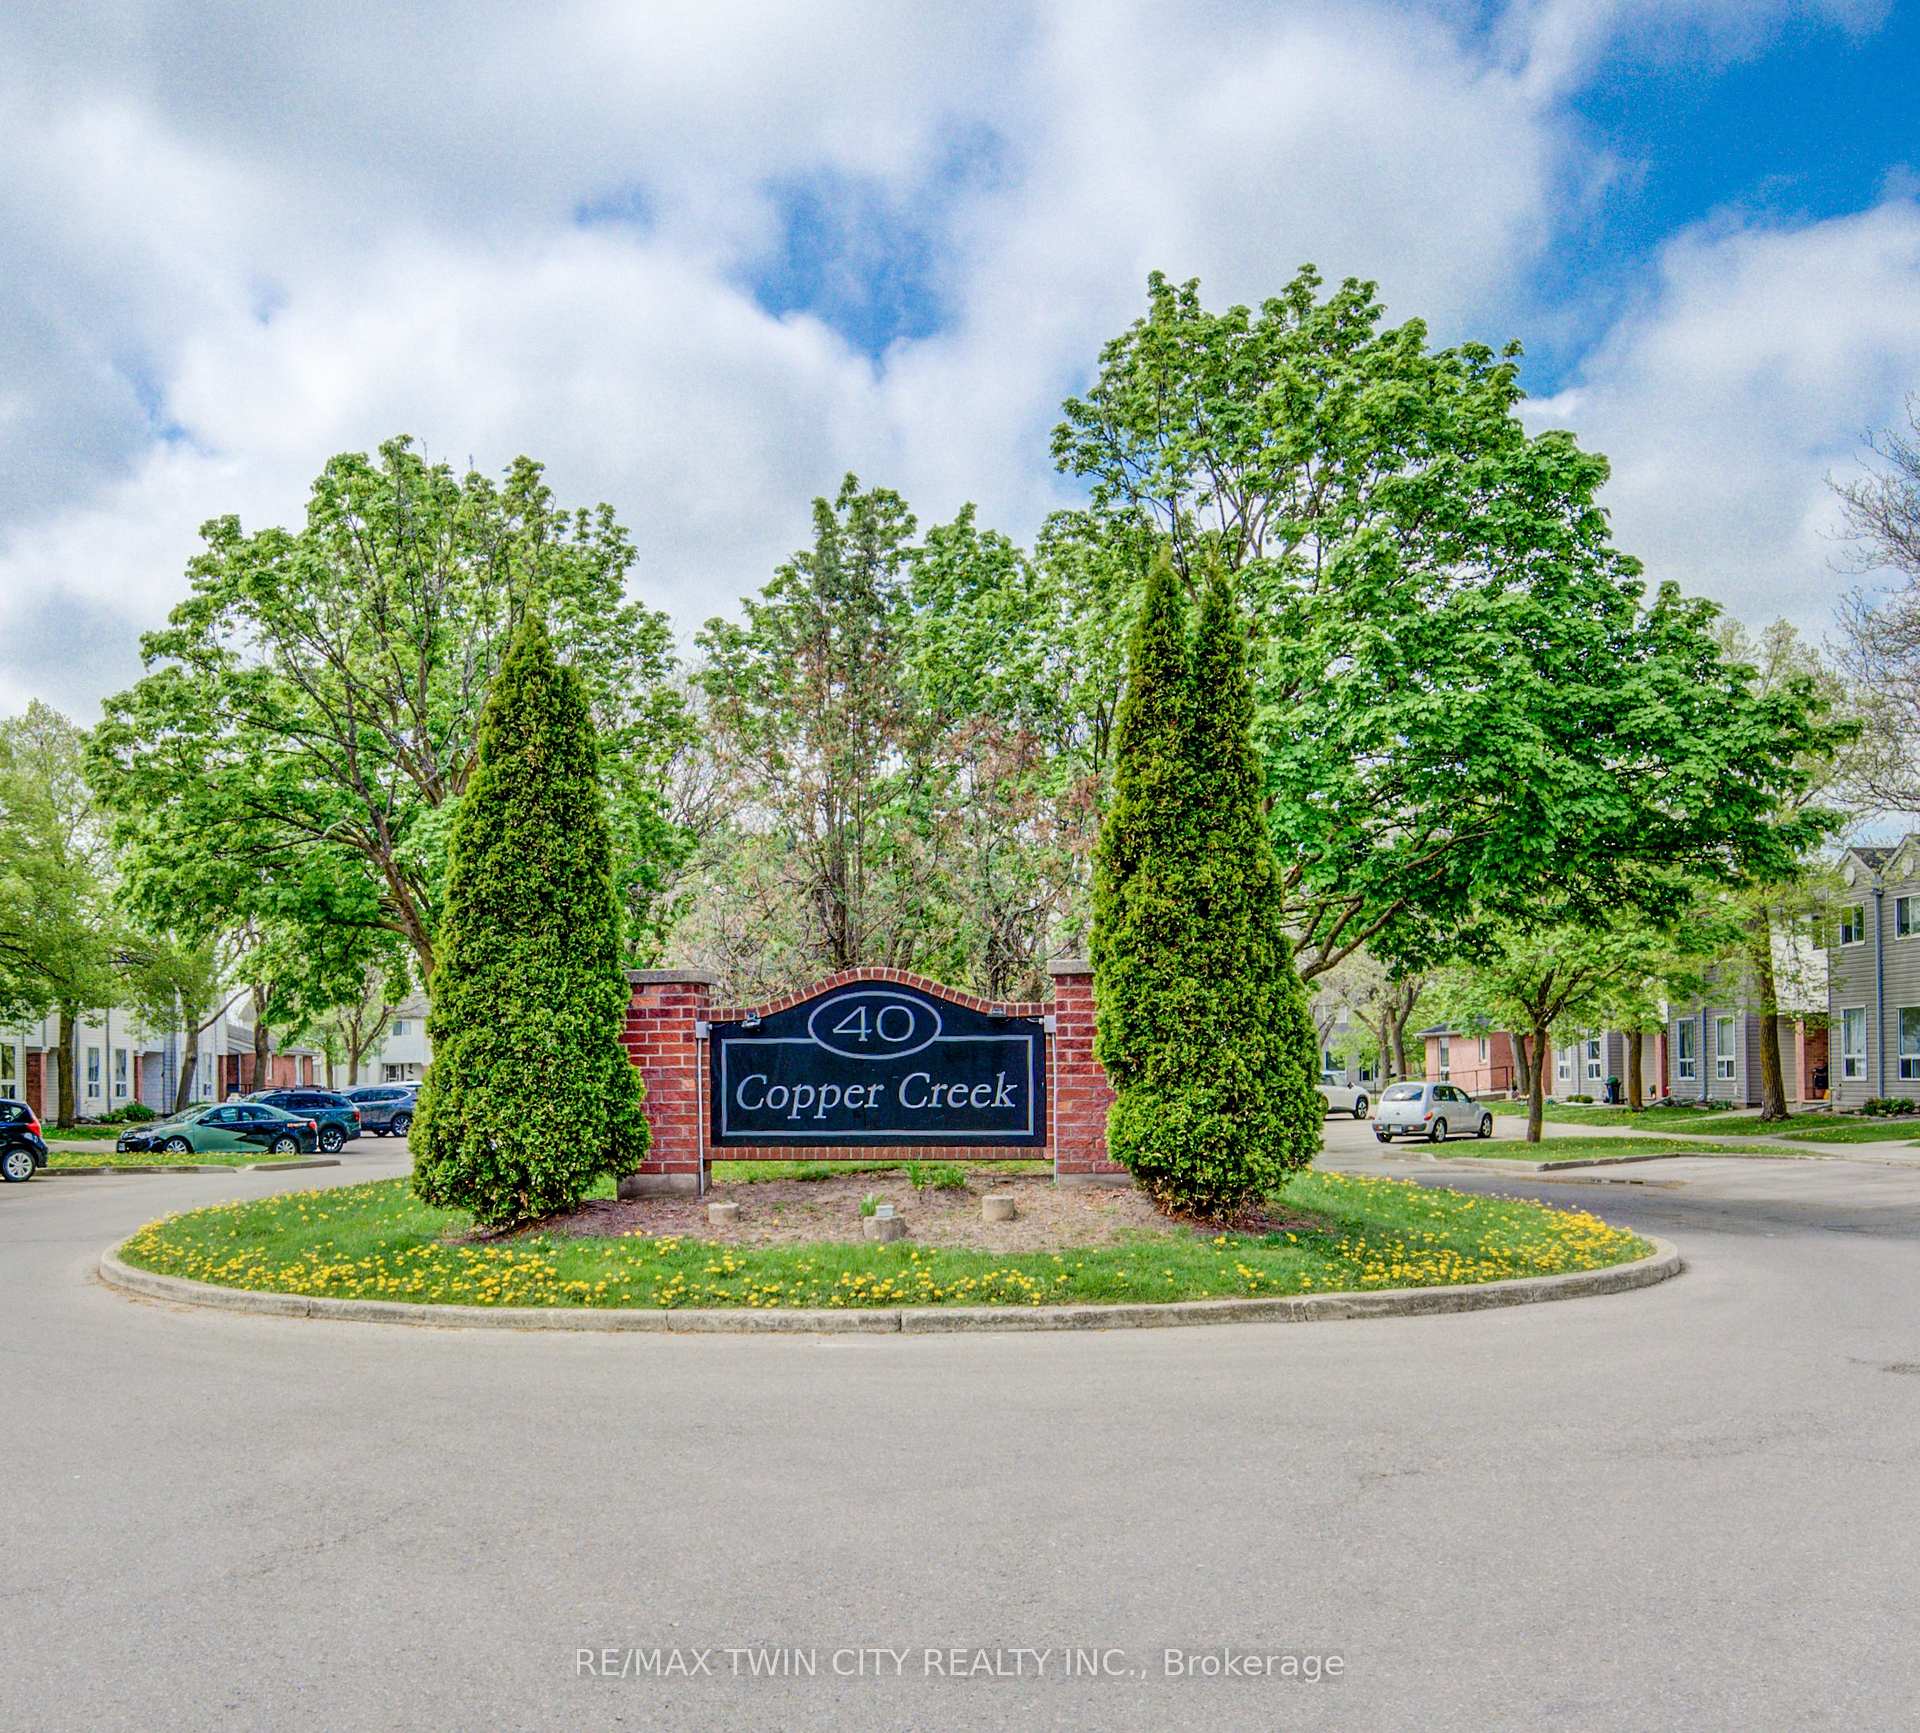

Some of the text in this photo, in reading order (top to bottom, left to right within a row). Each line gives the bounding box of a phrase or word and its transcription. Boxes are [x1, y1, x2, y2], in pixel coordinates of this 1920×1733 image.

[832, 1005, 916, 1043] 40
[736, 1071, 1019, 1119] Copper Creek
